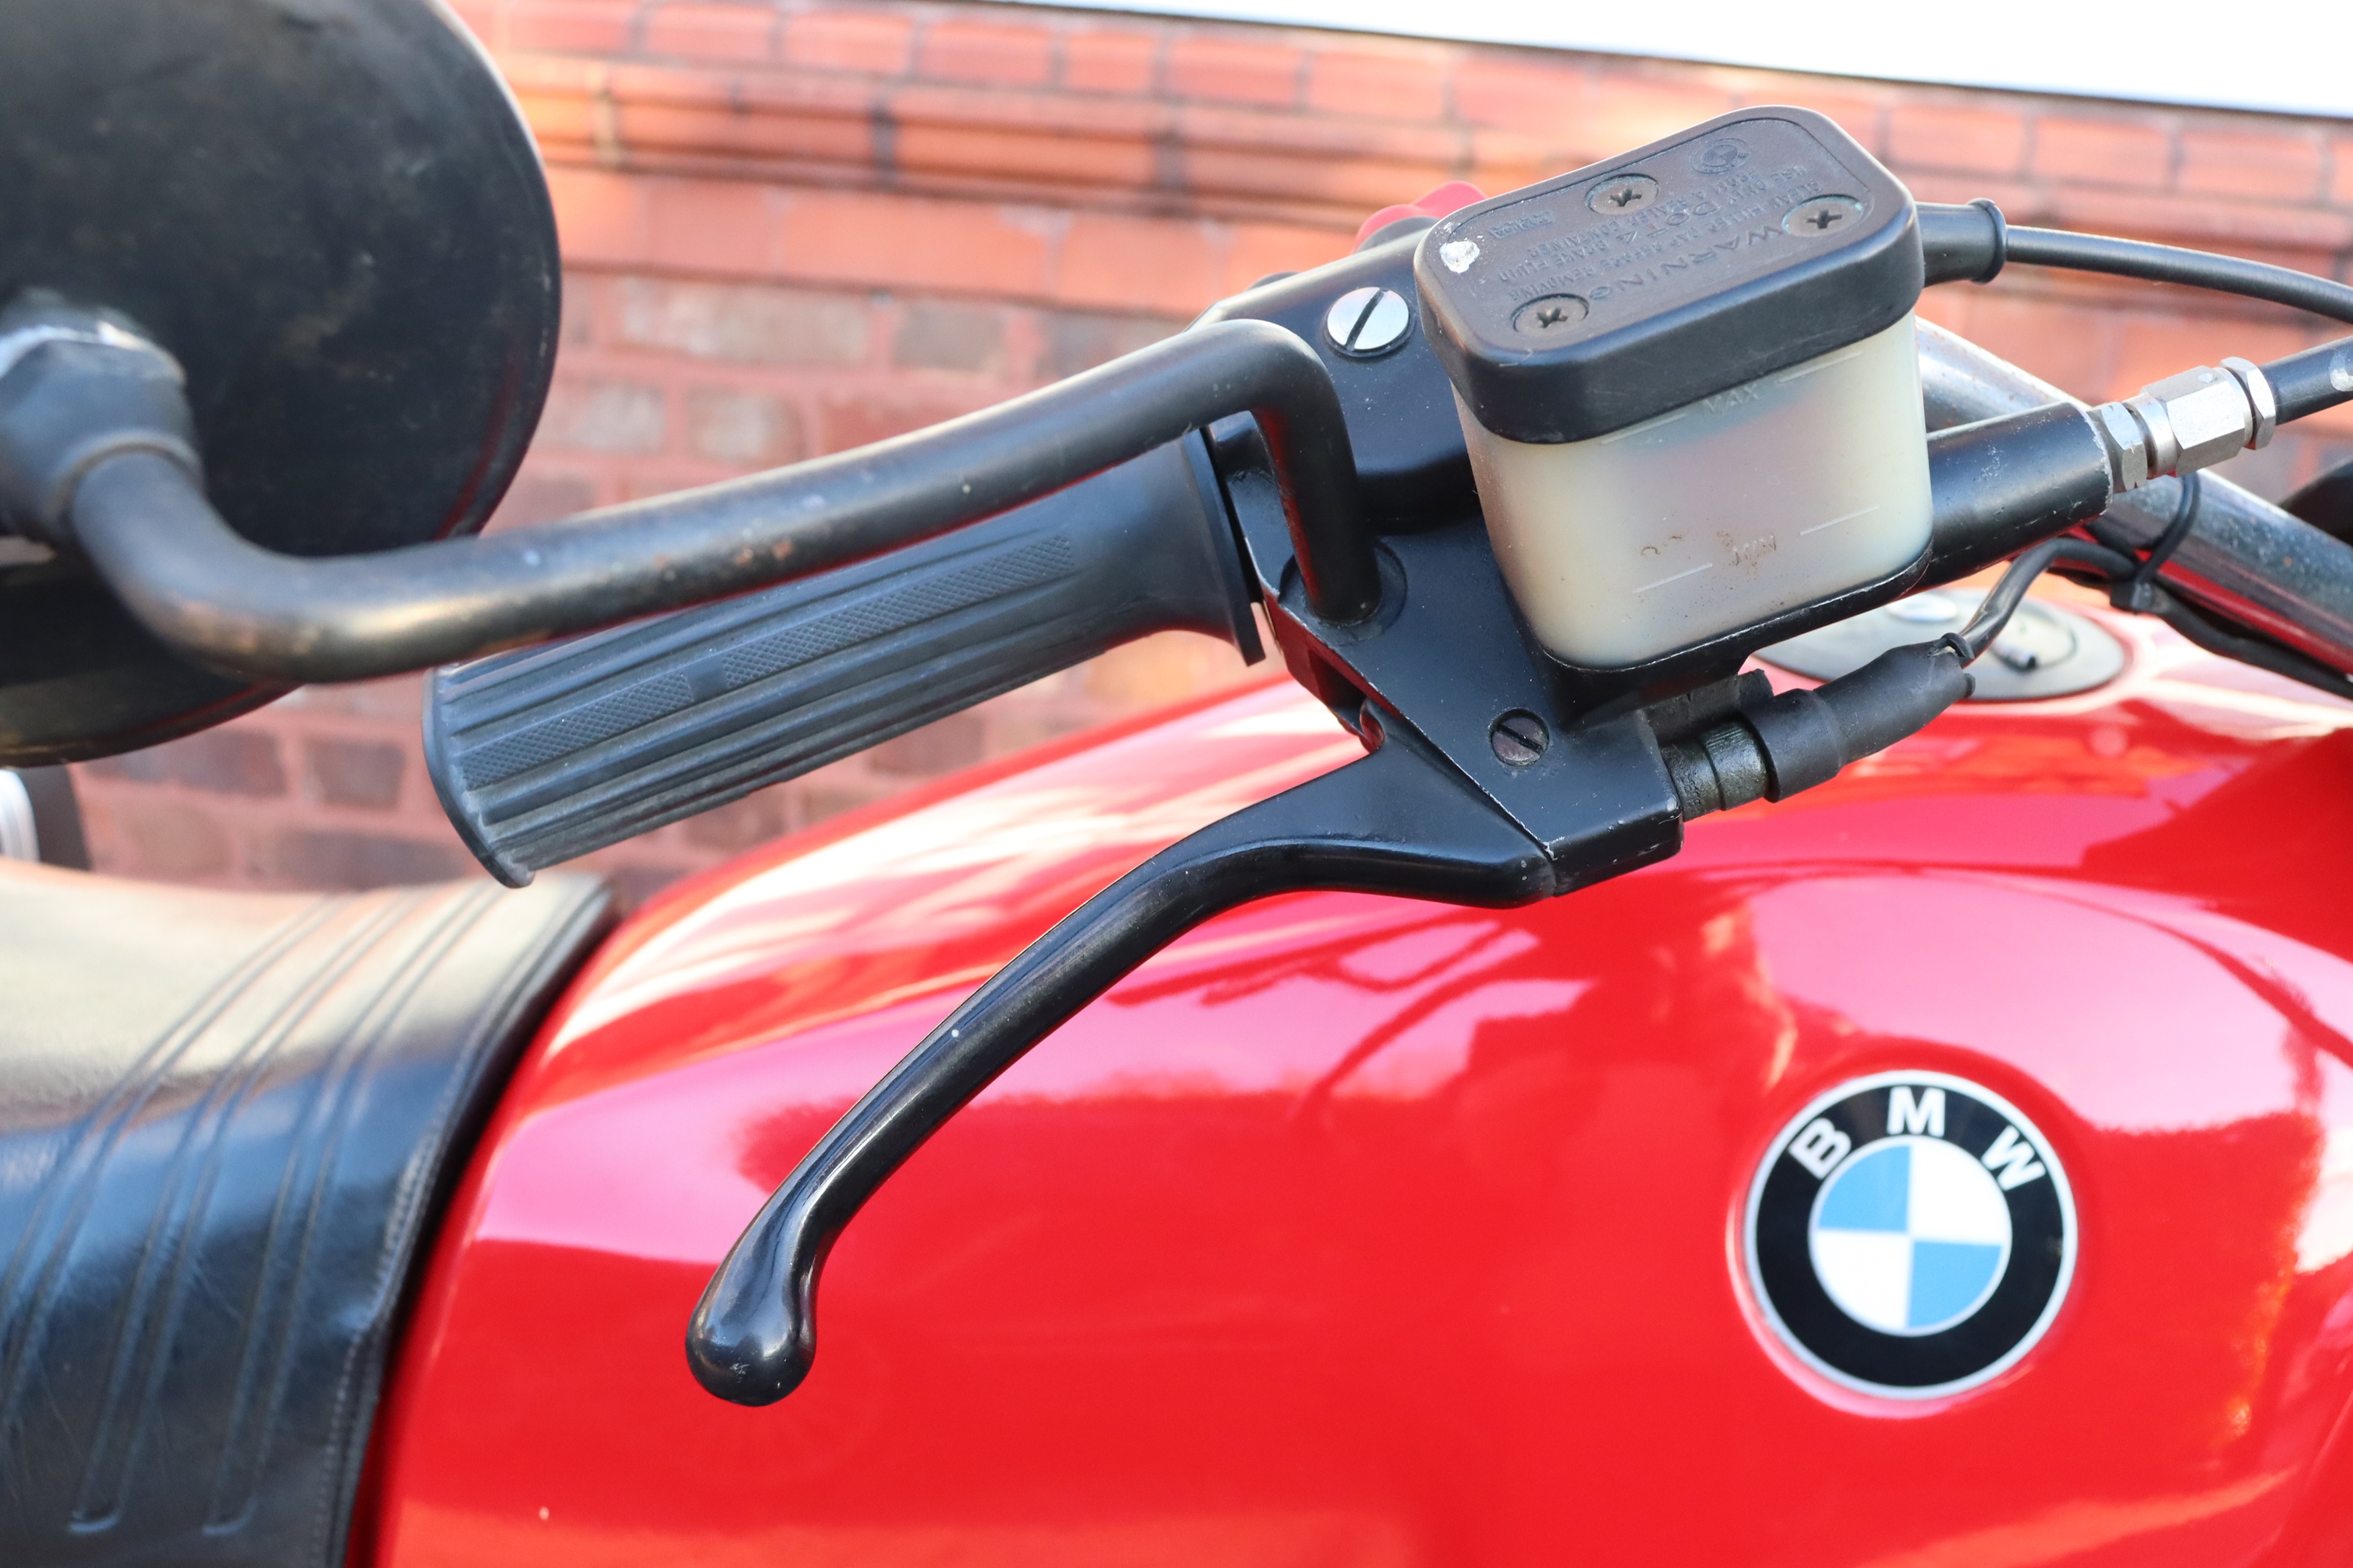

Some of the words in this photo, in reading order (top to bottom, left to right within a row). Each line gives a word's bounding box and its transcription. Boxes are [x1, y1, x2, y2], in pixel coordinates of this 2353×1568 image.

[1690, 189, 1706, 201] A
[1645, 201, 1719, 237] DOT
[1526, 220, 1622, 258] CONTAINER
[1553, 241, 1608, 265] BRAKE
[1616, 230, 1638, 245] 4
[1498, 259, 1550, 282] FLUID
[1588, 225, 1782, 300] WARNING
[1508, 265, 1596, 300] REMOVING
[1700, 384, 1759, 416] MAX
[1787, 1085, 2046, 1191] BMW
